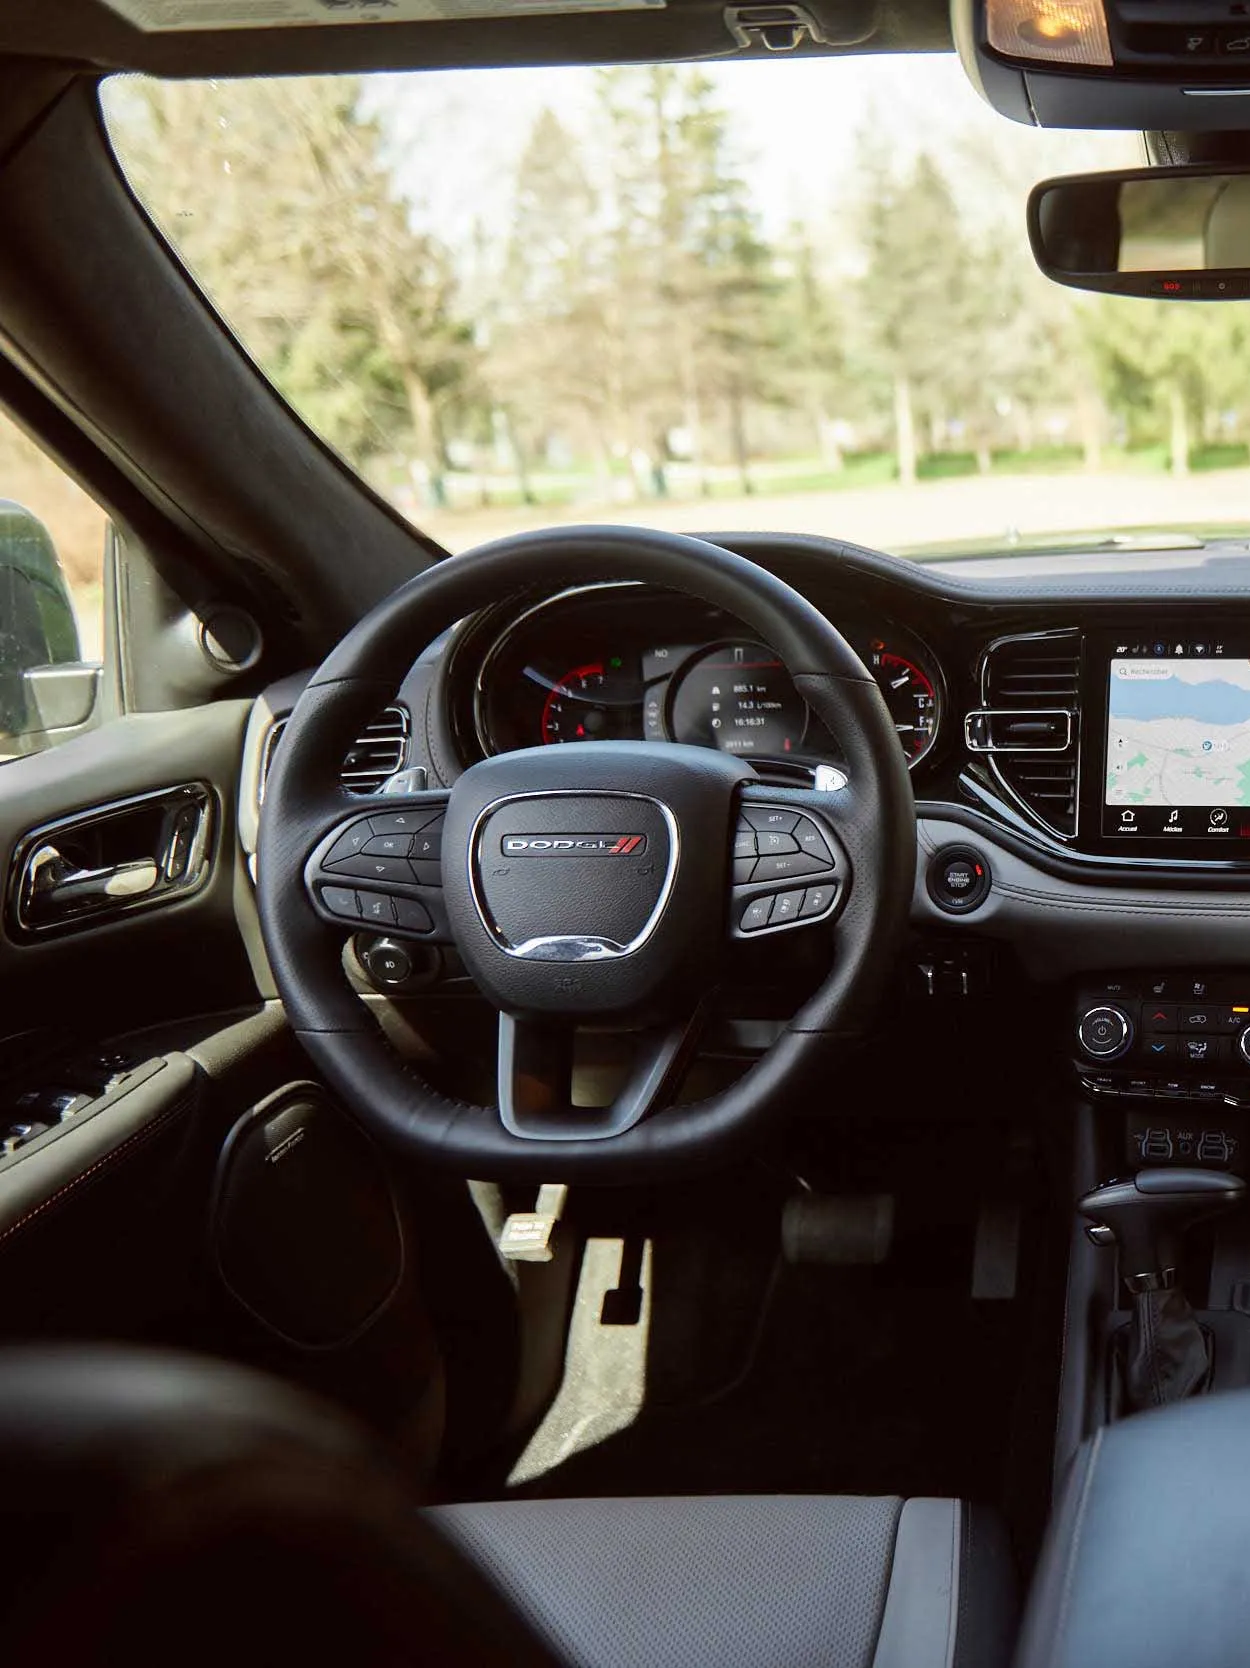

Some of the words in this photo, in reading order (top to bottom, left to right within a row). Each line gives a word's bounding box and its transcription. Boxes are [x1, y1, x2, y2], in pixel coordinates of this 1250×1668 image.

[1163, 281, 1181, 291] SOS
[654, 649, 669, 658] NO
[873, 654, 880, 665] H
[918, 697, 925, 709] C
[507, 840, 620, 850] DODGE
[1107, 984, 1121, 992] MUTE
[1228, 1016, 1241, 1024] A/C
[1177, 1131, 1194, 1140] AUX
